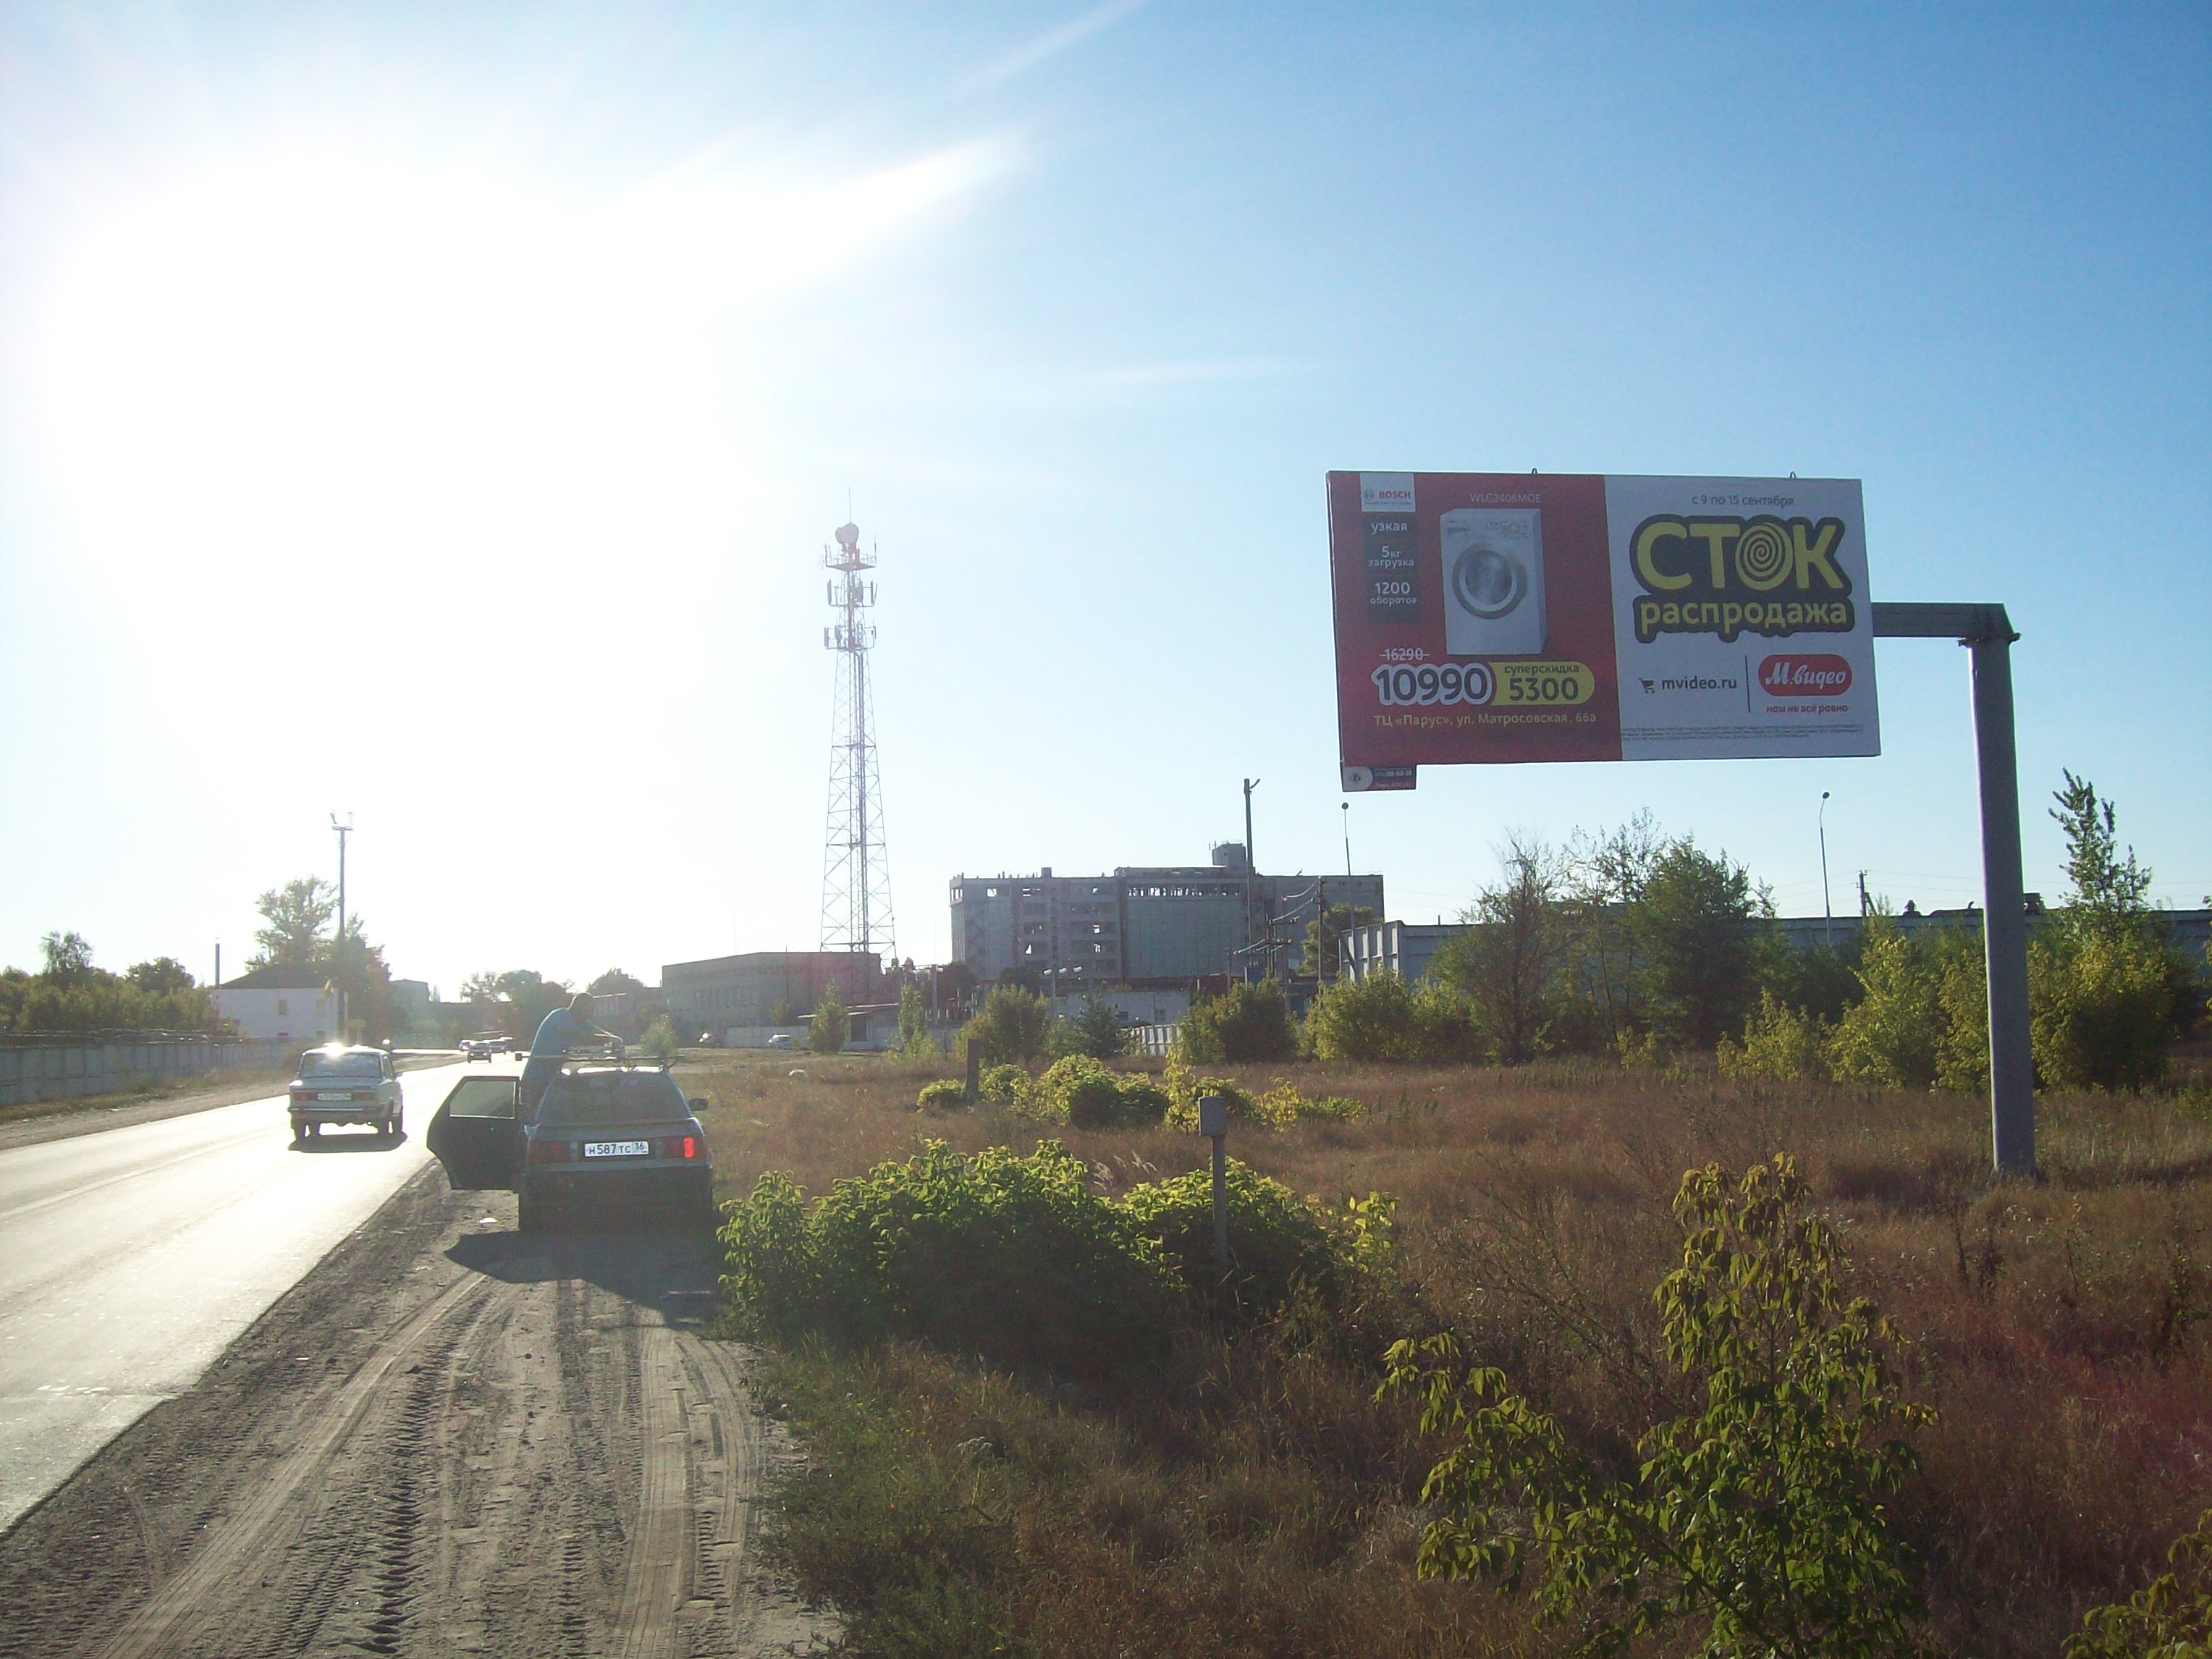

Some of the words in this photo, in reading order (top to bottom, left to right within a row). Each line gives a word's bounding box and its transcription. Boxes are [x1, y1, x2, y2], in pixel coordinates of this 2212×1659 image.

[1701, 494, 1707, 505] 9
[1711, 496, 1726, 505] по
[1728, 495, 1739, 505] 15
[1742, 495, 1794, 508] сентября
[1371, 523, 1408, 534] узкая
[1637, 521, 1844, 591] СТОК
[1369, 559, 1414, 570] загрузка
[1375, 582, 1411, 595] 1200
[1370, 596, 1417, 607] оборотов
[1641, 601, 1846, 635] распродажа
[1383, 648, 1424, 661] 16290
[1504, 664, 1579, 676] суперскидка
[1376, 667, 1487, 701] 10990
[1508, 677, 1579, 701] 5300
[1661, 675, 1737, 690] mvideo.ru
[1818, 706, 1848, 715] равно
[1374, 715, 1393, 727] ТЦ
[1456, 716, 1474, 727] ул.
[1575, 712, 1596, 722] 66а
